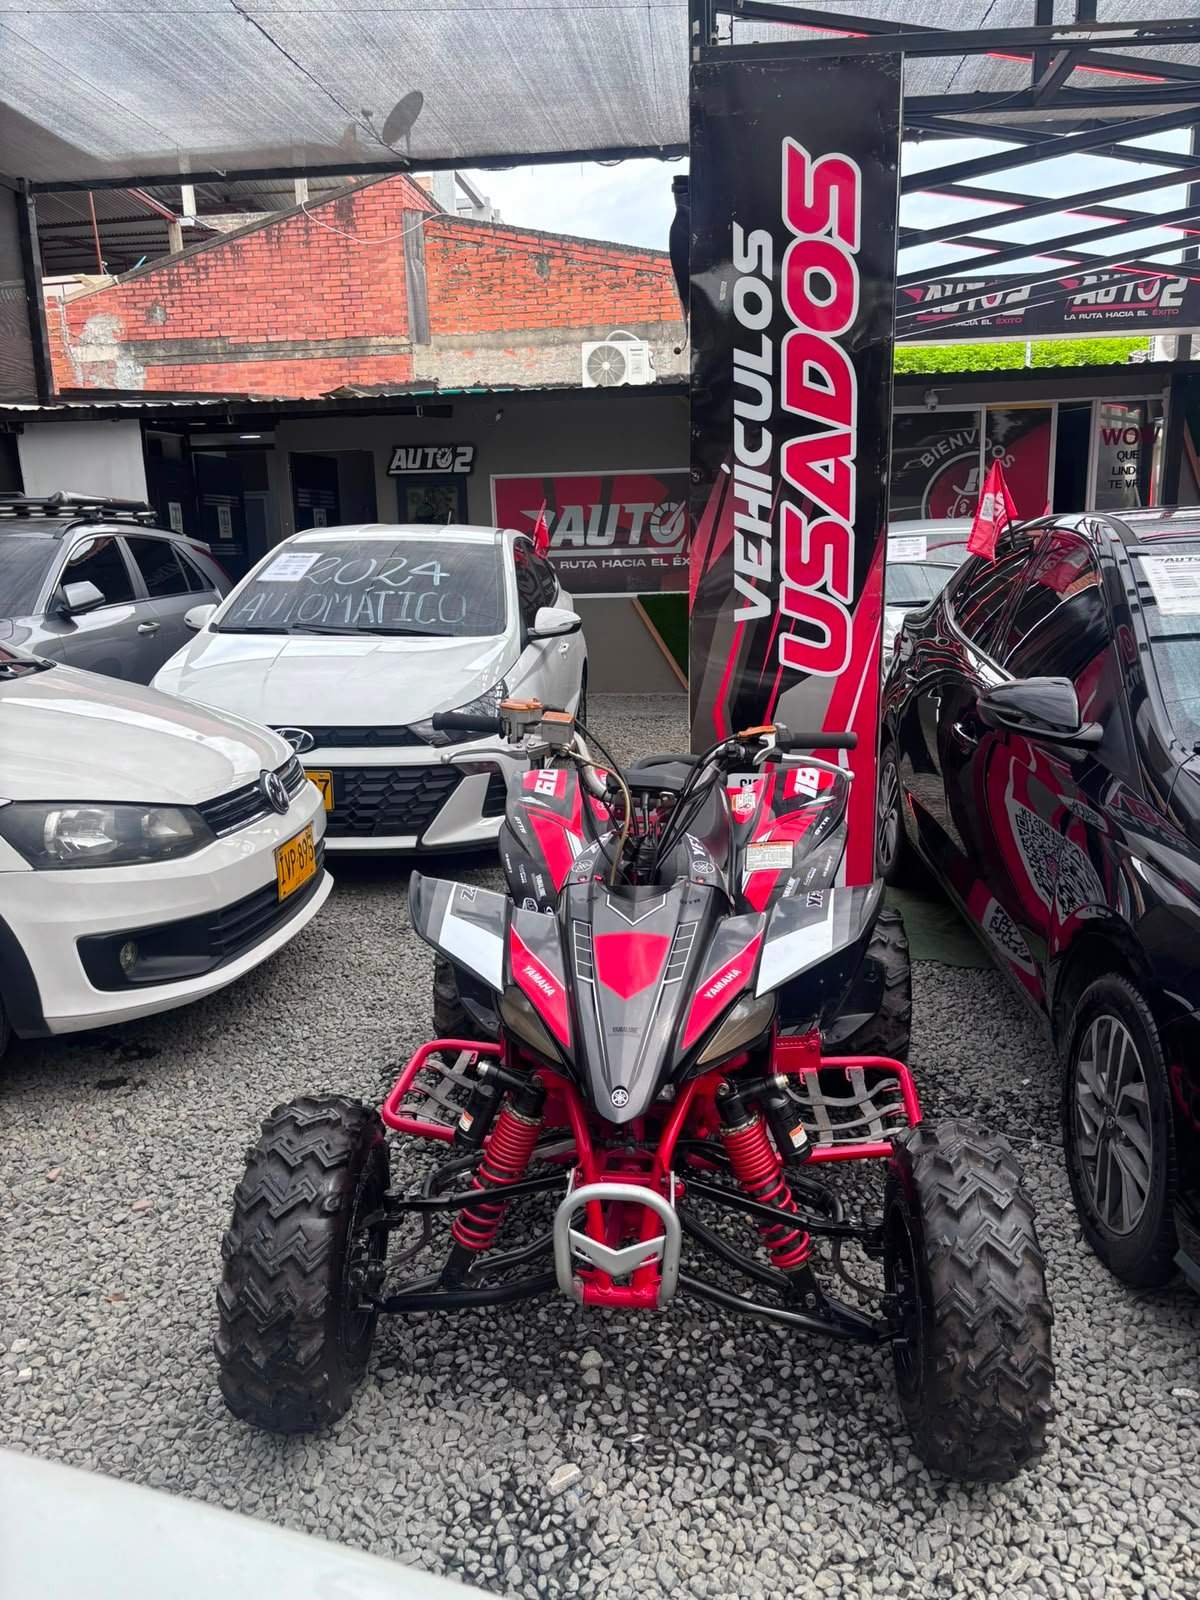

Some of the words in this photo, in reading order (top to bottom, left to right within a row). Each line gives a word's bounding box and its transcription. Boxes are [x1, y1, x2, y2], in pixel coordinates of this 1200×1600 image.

[981, 318, 993, 326] EL
[995, 316, 1023, 325] ÉXITO
[1079, 312, 1103, 320] RUTA
[1105, 310, 1135, 318] HACIA
[1137, 309, 1149, 317] EL
[1152, 307, 1180, 316] ÉXITO
[778, 136, 861, 677] USADOS
[720, 221, 773, 622] VEHÍCULOS
[1101, 426, 1162, 447] WOW
[388, 445, 474, 474] AUTO2
[1116, 450, 1140, 463] QUE
[1109, 480, 1122, 489] TE
[304, 556, 450, 587] 2024
[560, 560, 598, 570] RUTA
[602, 558, 647, 568] HACIA
[651, 557, 669, 567] EL
[233, 586, 467, 625] AUTOMÁTICO
[522, 964, 556, 997] YAMAHA
[703, 968, 742, 999] YAMAHA
